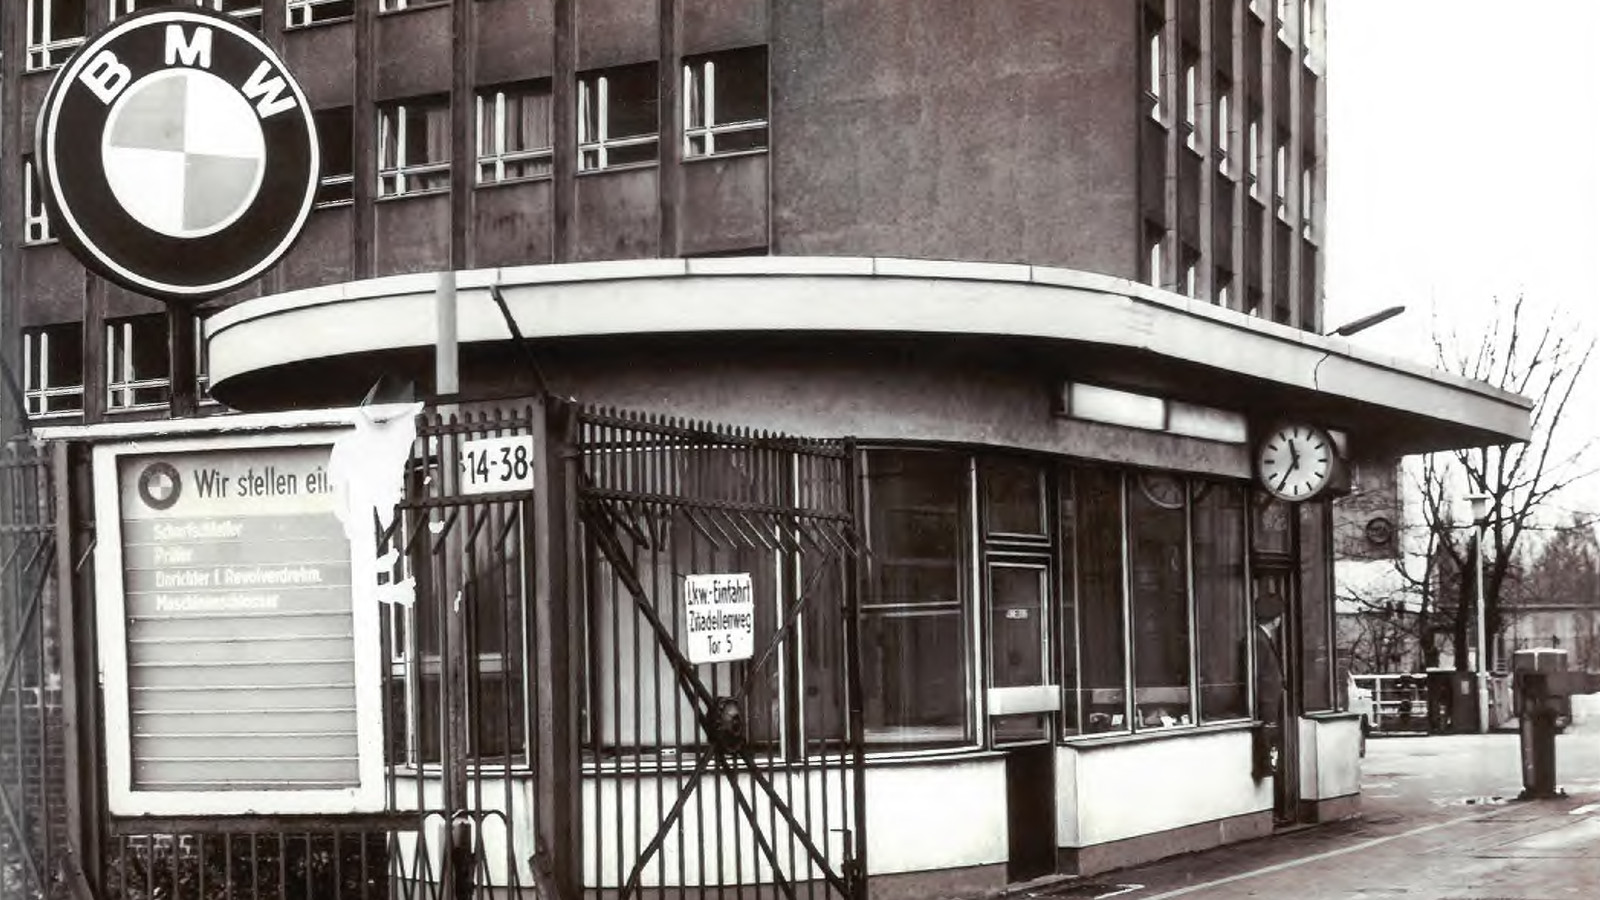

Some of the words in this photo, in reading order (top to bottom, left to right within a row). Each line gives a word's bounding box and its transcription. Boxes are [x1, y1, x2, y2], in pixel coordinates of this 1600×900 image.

[79, 24, 297, 119] BMW
[467, 445, 528, 484] 14-38
[194, 469, 229, 498] Wir
[238, 466, 297, 496] stellen
[689, 609, 752, 634] Zitadellenweg
[707, 635, 722, 656] Tor
[725, 633, 734, 654] 5
